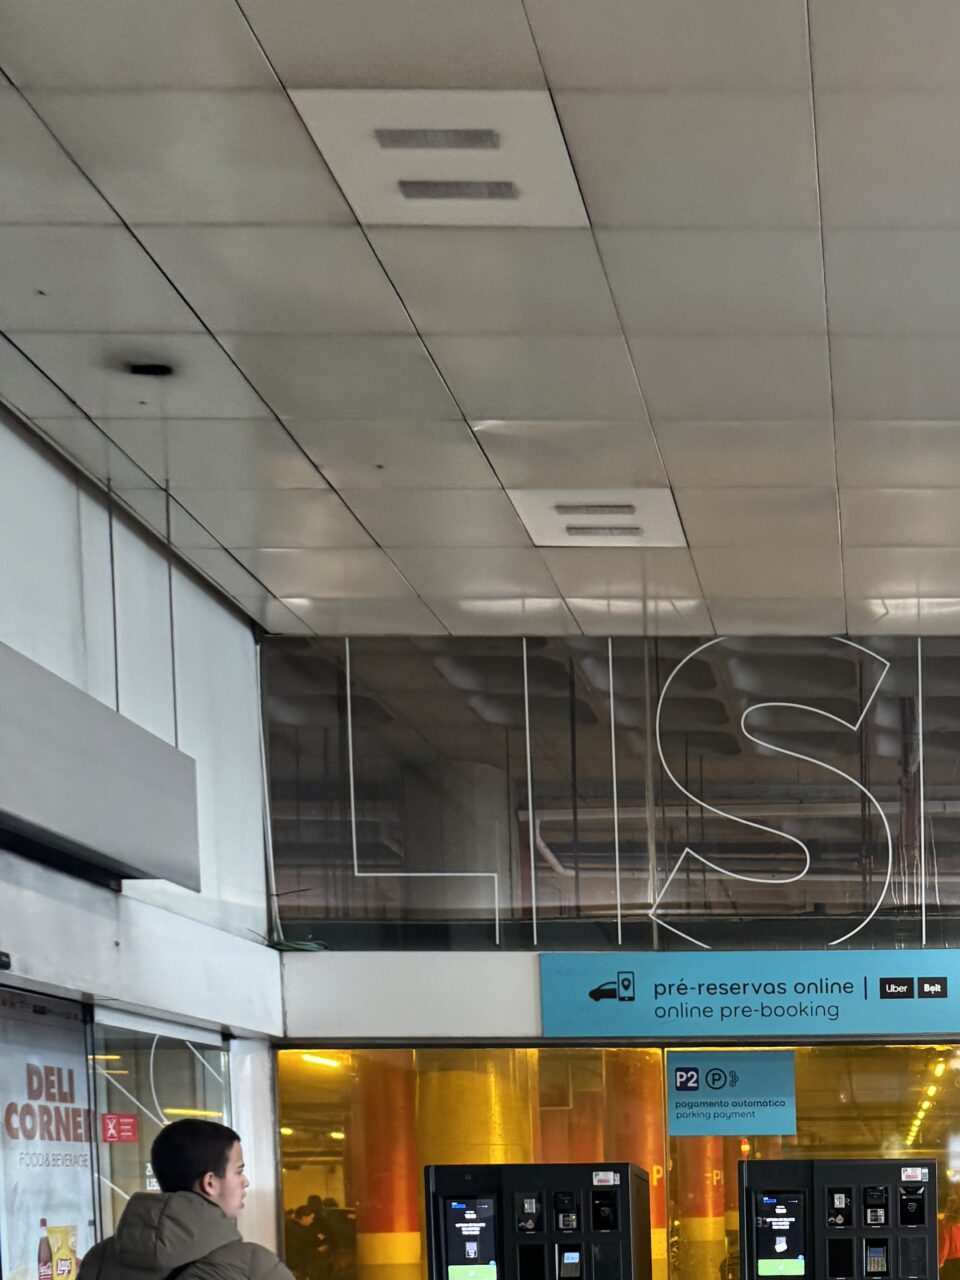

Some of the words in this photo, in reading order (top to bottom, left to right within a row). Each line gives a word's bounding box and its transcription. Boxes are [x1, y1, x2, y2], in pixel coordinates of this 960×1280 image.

[654, 978, 787, 999] pré-reservas
[793, 977, 854, 995] online
[885, 984, 908, 993] Uber
[923, 983, 942, 994] Bolt
[654, 1002, 714, 1018] online
[720, 1001, 839, 1021] pre-booking
[26, 1063, 75, 1104] DELI
[676, 1071, 698, 1088] P2
[675, 1100, 729, 1110] pagamento
[731, 1099, 786, 1108] automático
[676, 1110, 711, 1120] parking
[713, 1110, 756, 1120] payment
